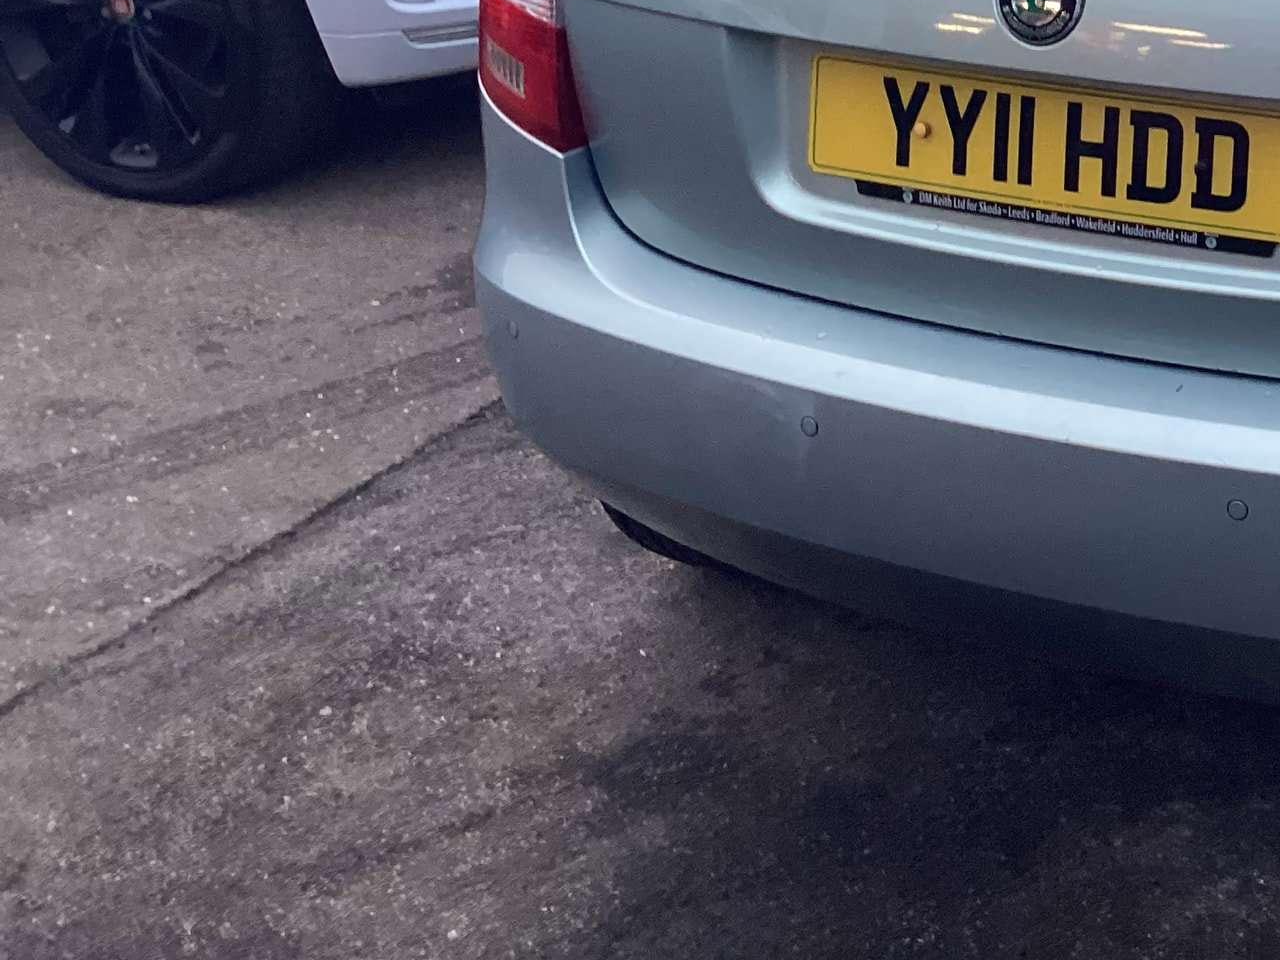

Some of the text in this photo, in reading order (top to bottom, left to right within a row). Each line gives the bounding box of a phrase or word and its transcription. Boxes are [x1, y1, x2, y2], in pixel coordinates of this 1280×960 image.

[883, 76, 1250, 213] YY11 HDD
[919, 191, 1198, 245] DM Keith Ltd for Skoda Leeds Bradford Wakefield Huddersfield Hull
